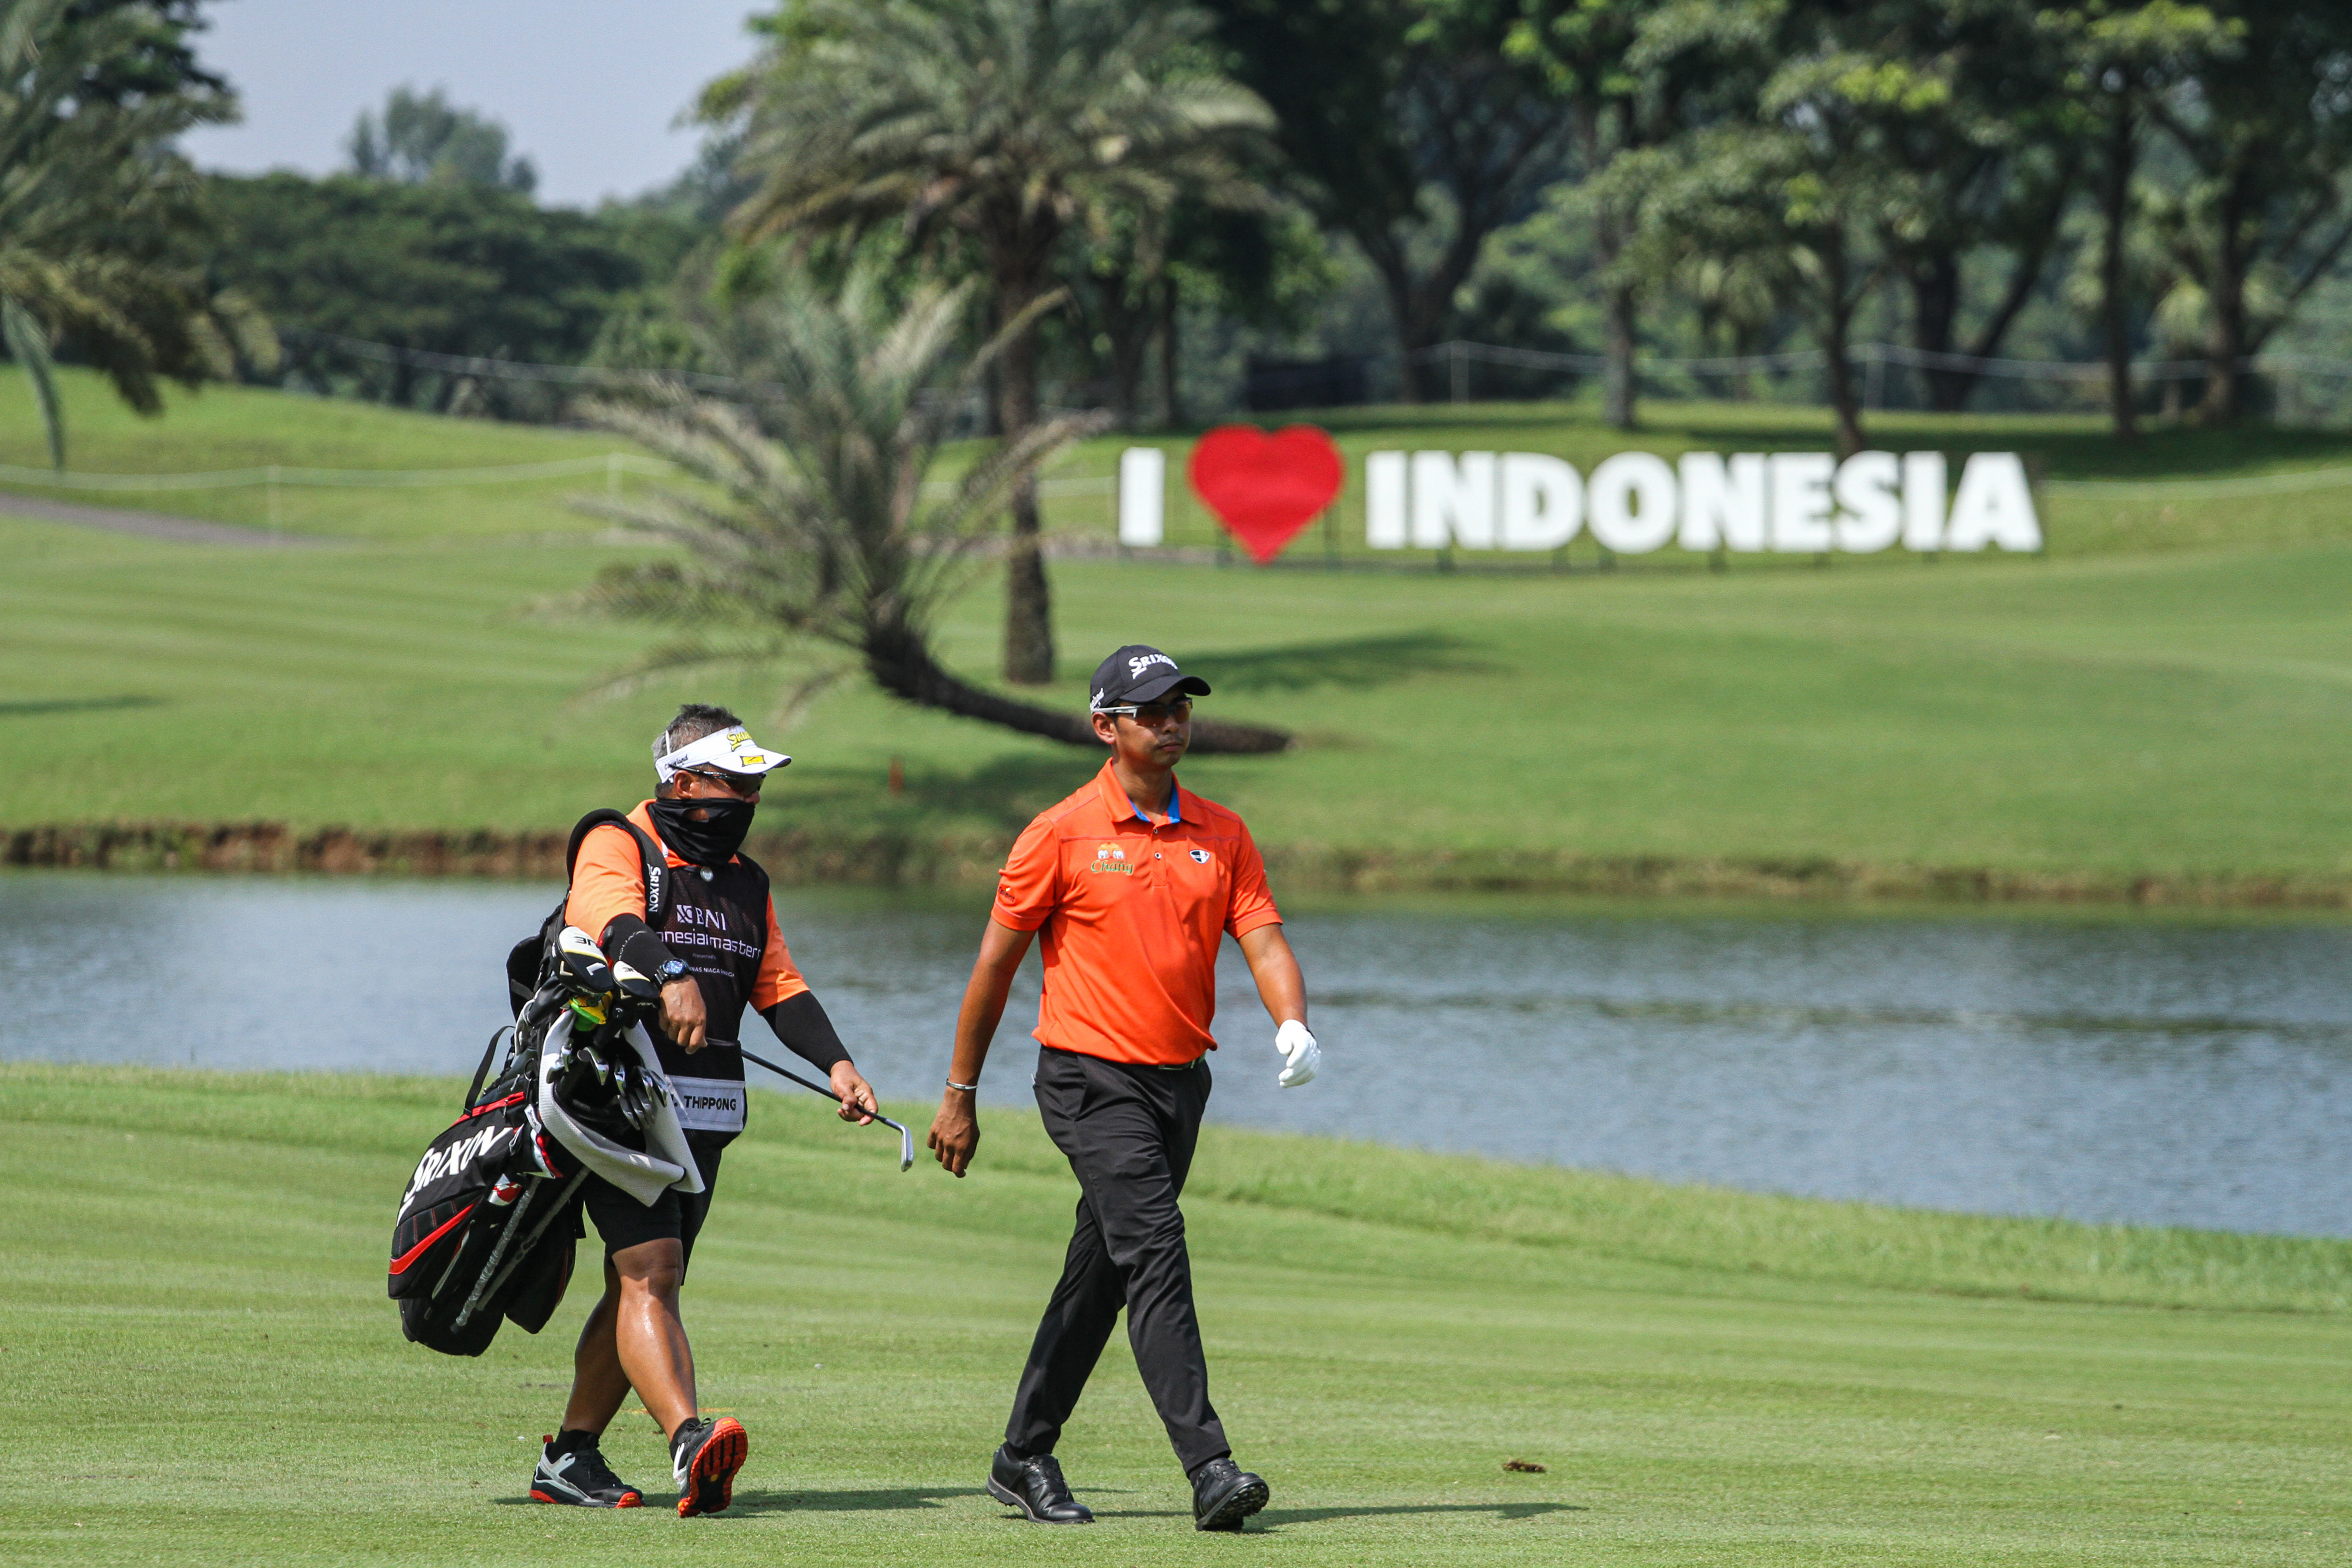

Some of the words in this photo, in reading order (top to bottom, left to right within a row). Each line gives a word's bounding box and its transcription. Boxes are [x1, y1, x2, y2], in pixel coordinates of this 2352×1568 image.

[1118, 447, 1165, 547] I
[1365, 450, 2042, 553] INDONESIA
[647, 863, 662, 912] SRIXON
[1091, 860, 1133, 875] Chang
[695, 907, 727, 931] BNI
[397, 1125, 513, 1226] SRIXON
